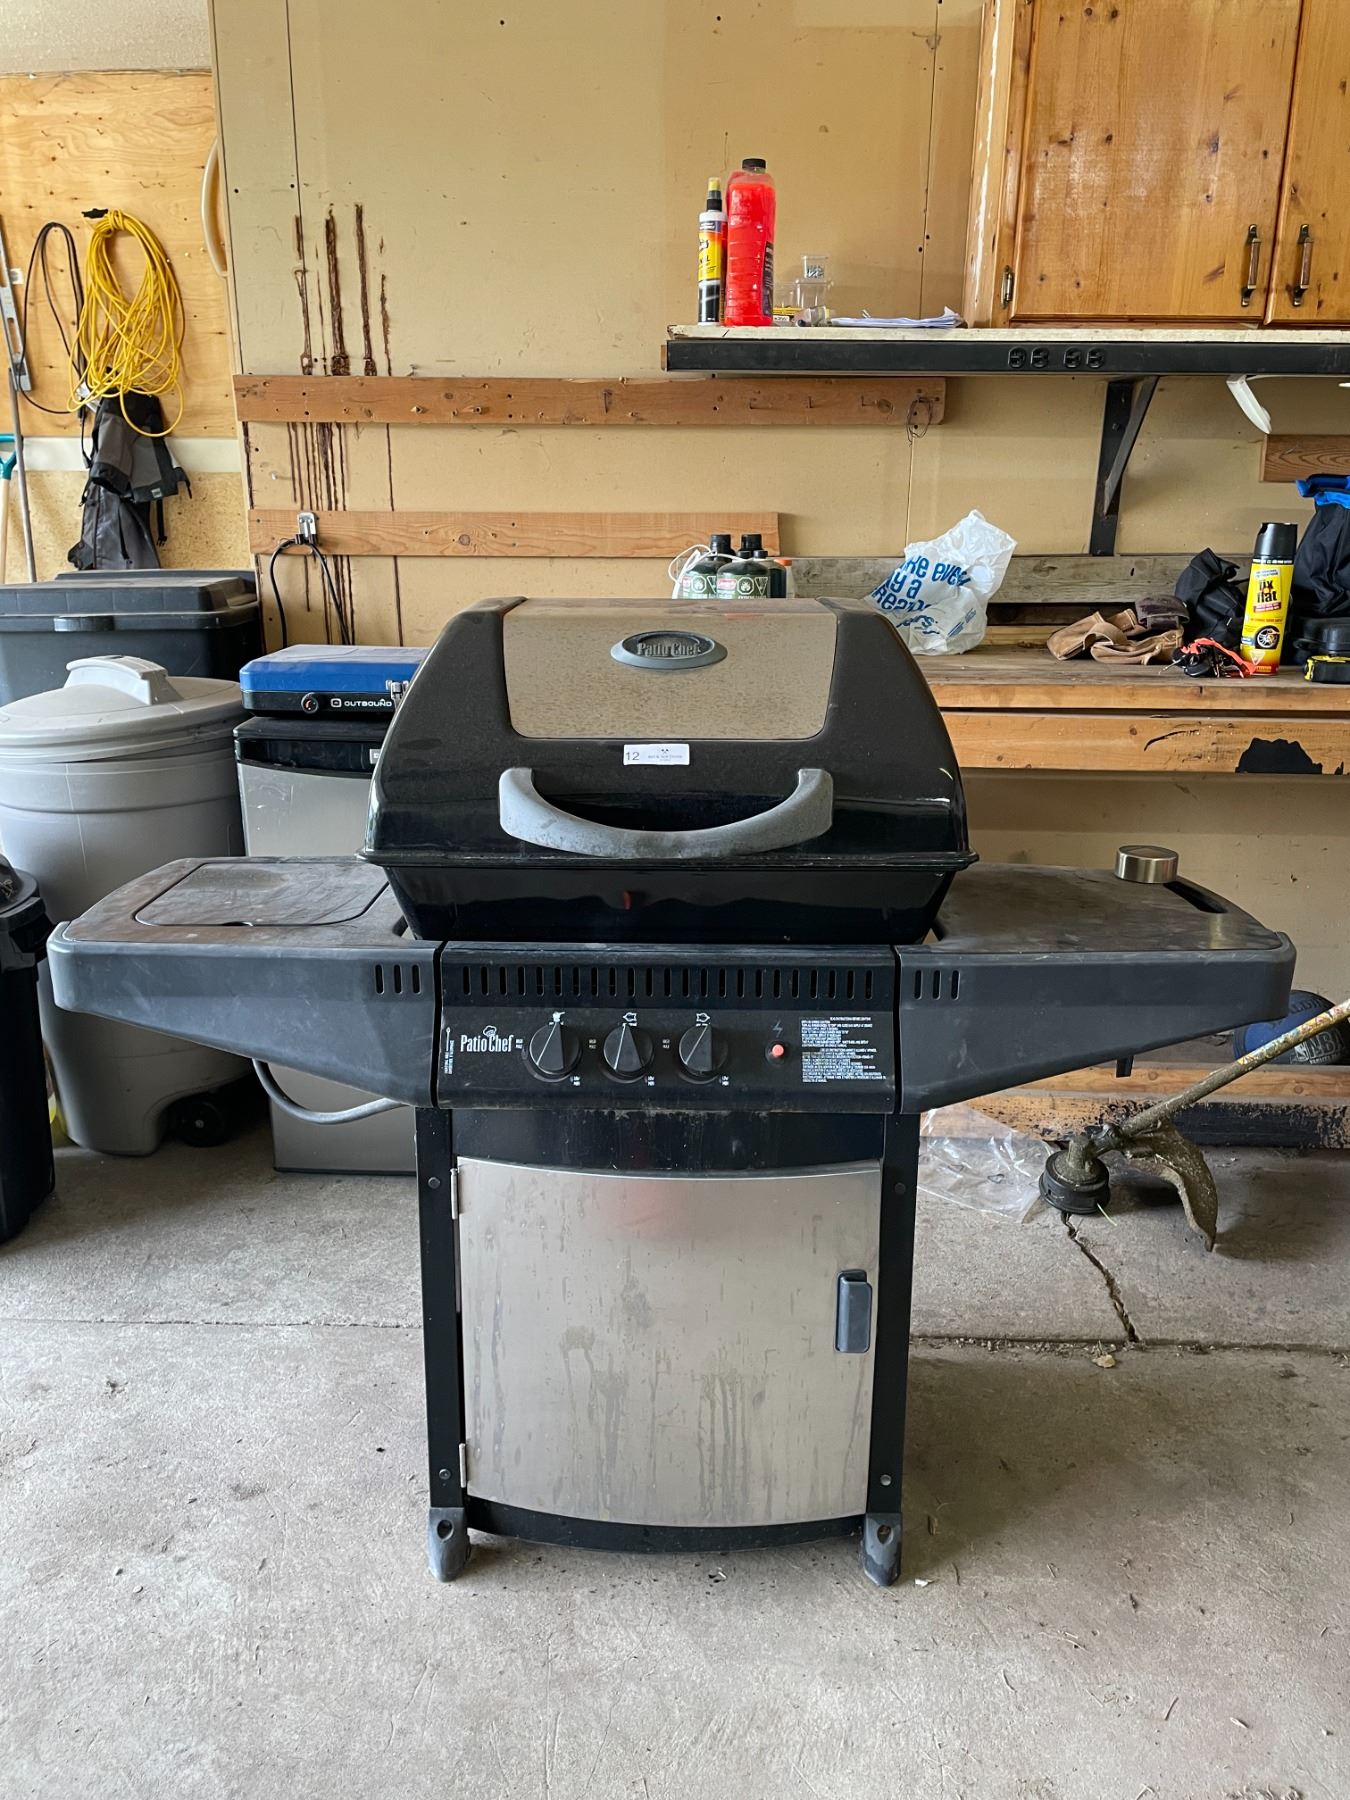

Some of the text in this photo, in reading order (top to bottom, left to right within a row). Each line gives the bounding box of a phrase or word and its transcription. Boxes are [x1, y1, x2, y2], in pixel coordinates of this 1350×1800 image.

[907, 579, 922, 600] a
[344, 698, 393, 707] OUTBOUND
[625, 751, 640, 761] 12
